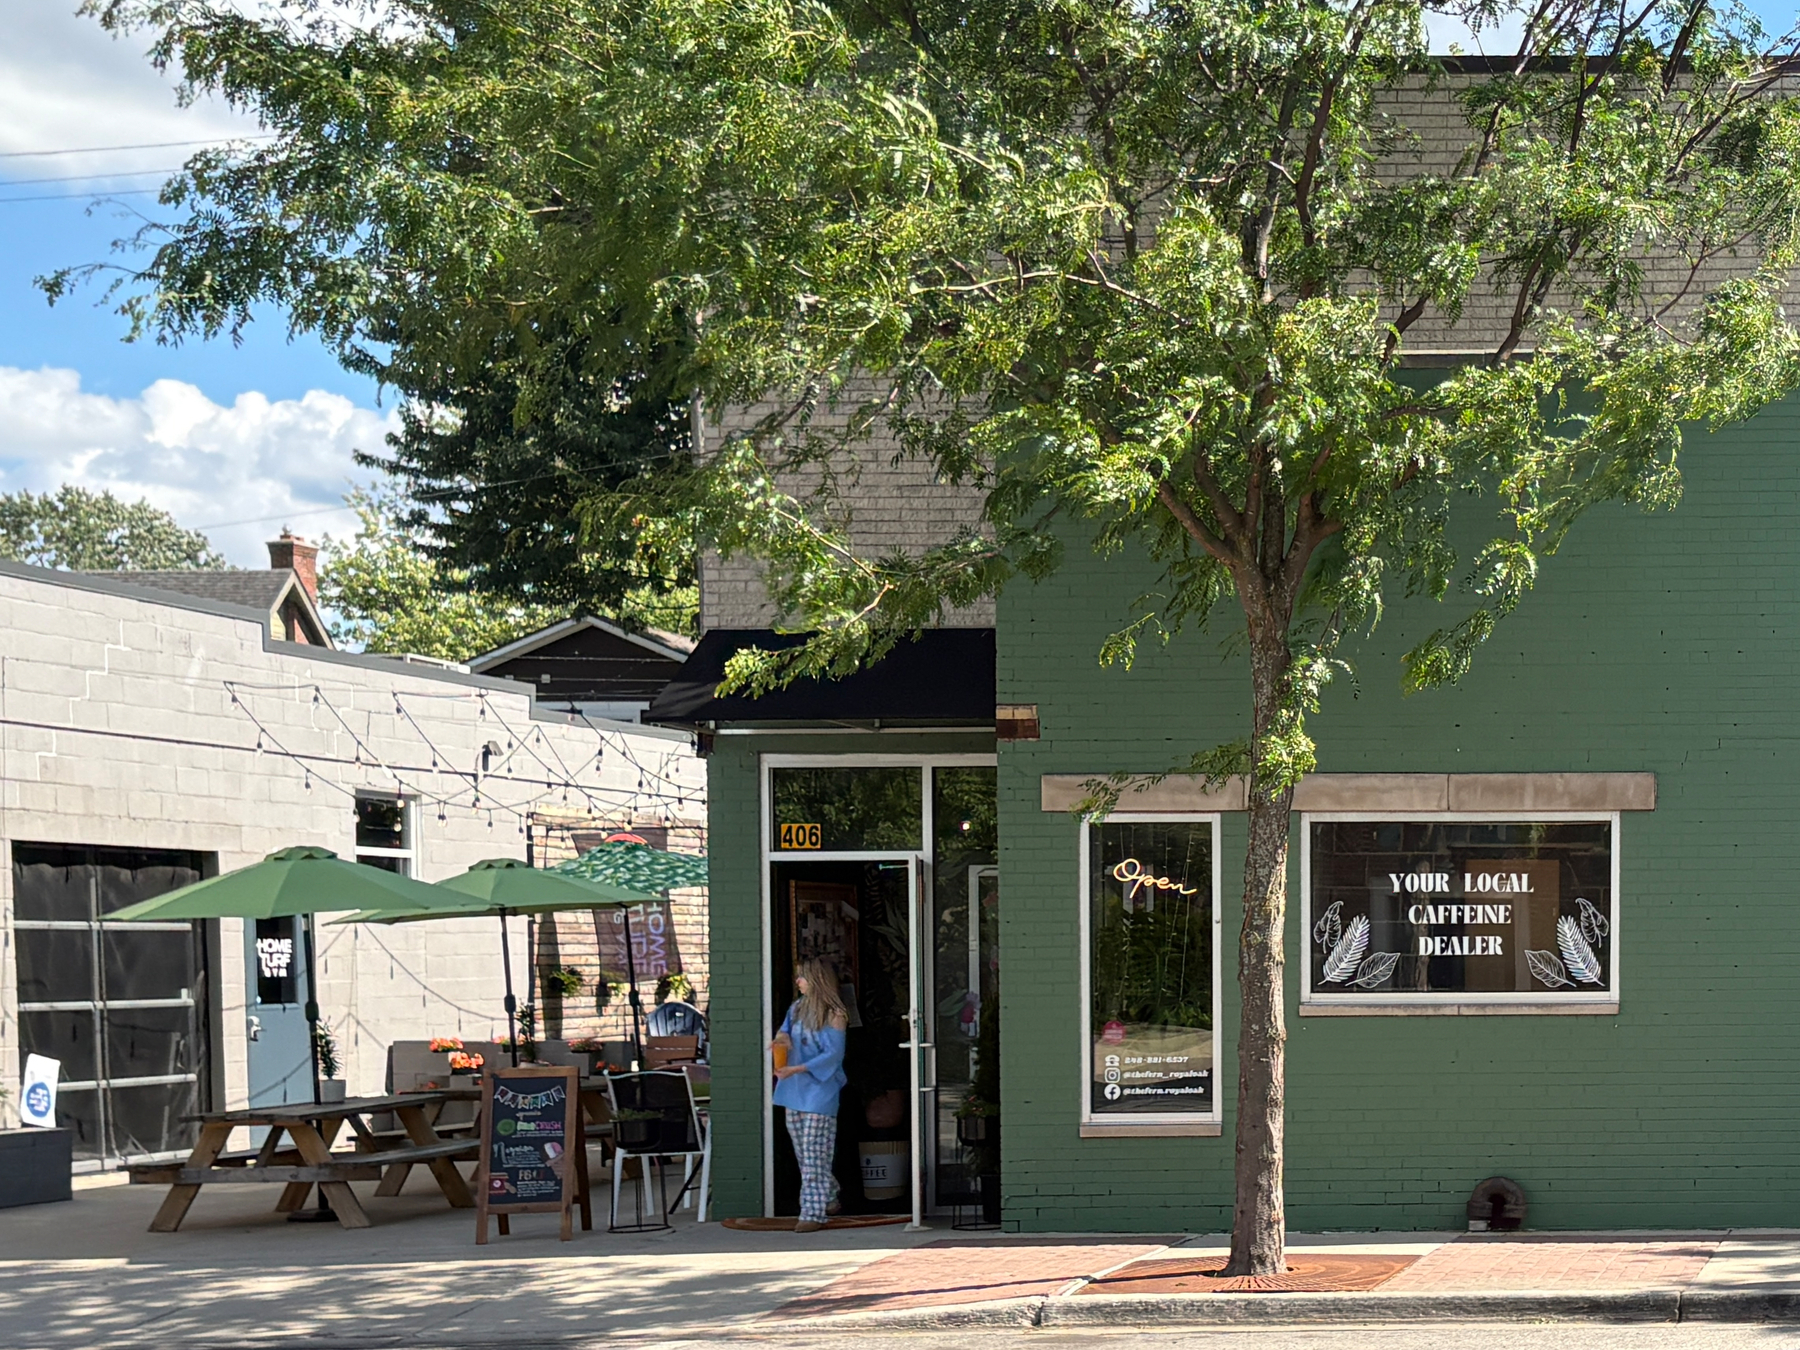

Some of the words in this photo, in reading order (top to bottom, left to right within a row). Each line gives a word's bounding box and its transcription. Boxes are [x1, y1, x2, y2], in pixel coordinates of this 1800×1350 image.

[782, 824, 820, 847] 406
[1113, 858, 1197, 899] Open
[1388, 872, 1450, 893] YOUR
[1463, 872, 1534, 893] LOCAL
[1408, 904, 1511, 925] CAFFEINE
[256, 938, 292, 953] HOME
[1418, 935, 1503, 956] DEALER
